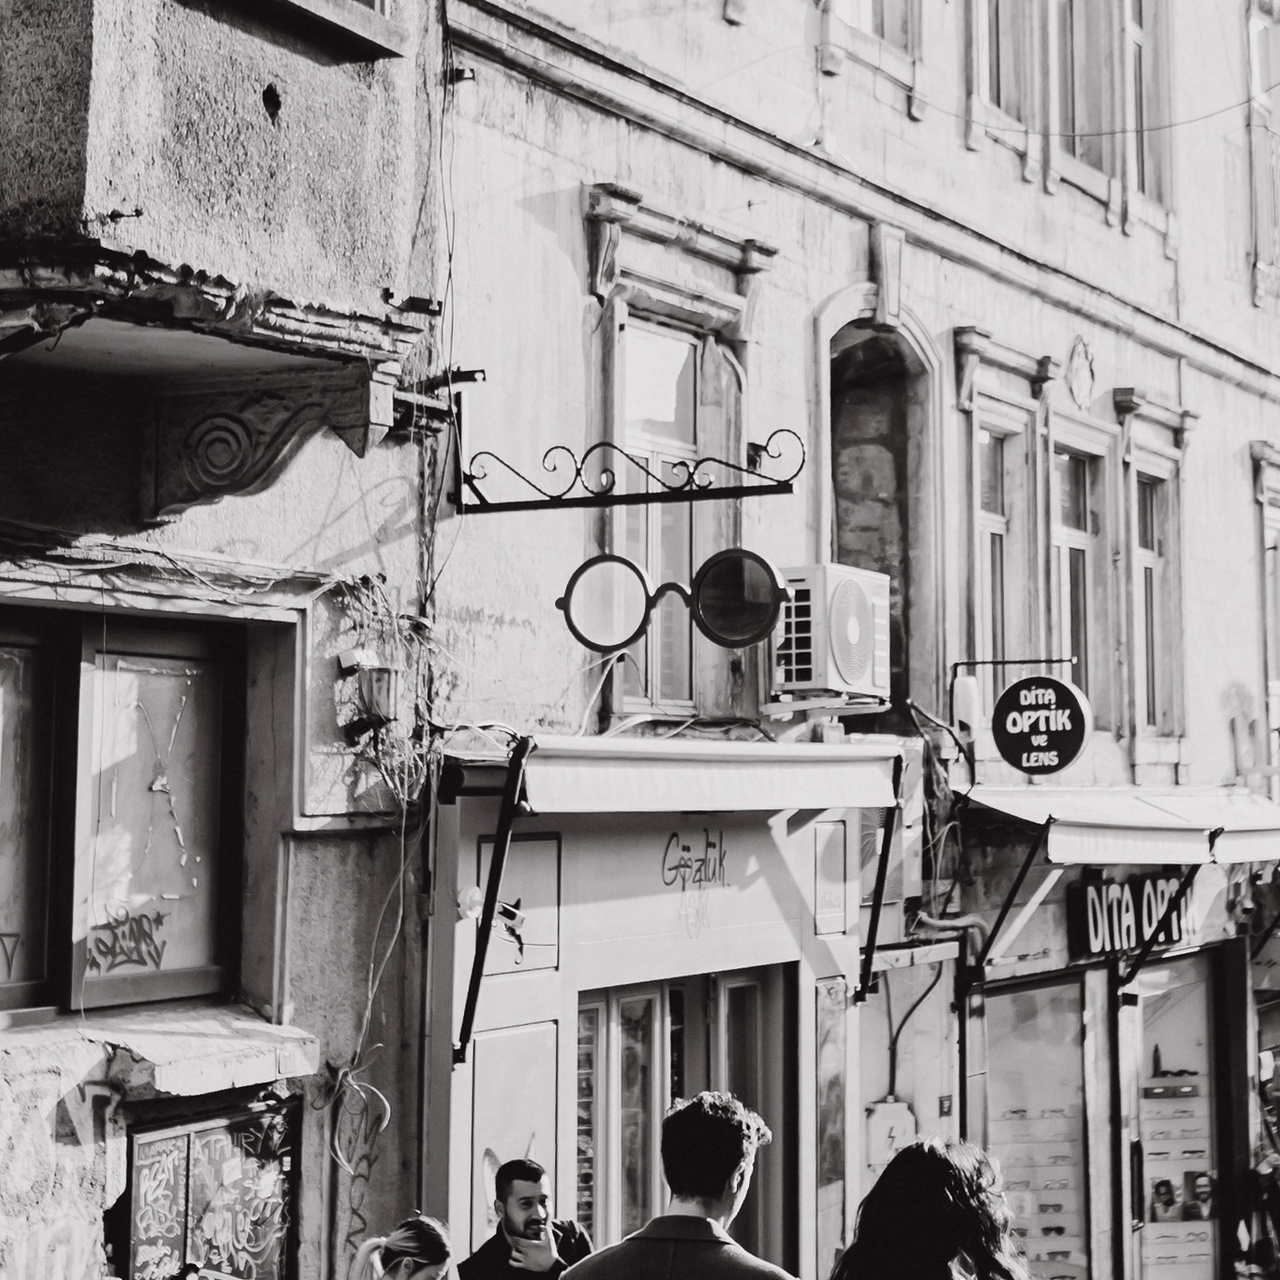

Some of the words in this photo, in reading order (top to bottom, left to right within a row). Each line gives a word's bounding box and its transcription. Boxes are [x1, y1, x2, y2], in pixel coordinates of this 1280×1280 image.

[1020, 685, 1056, 706] DİTA
[1006, 704, 1072, 734] OPTİK
[1022, 750, 1059, 767] LENS
